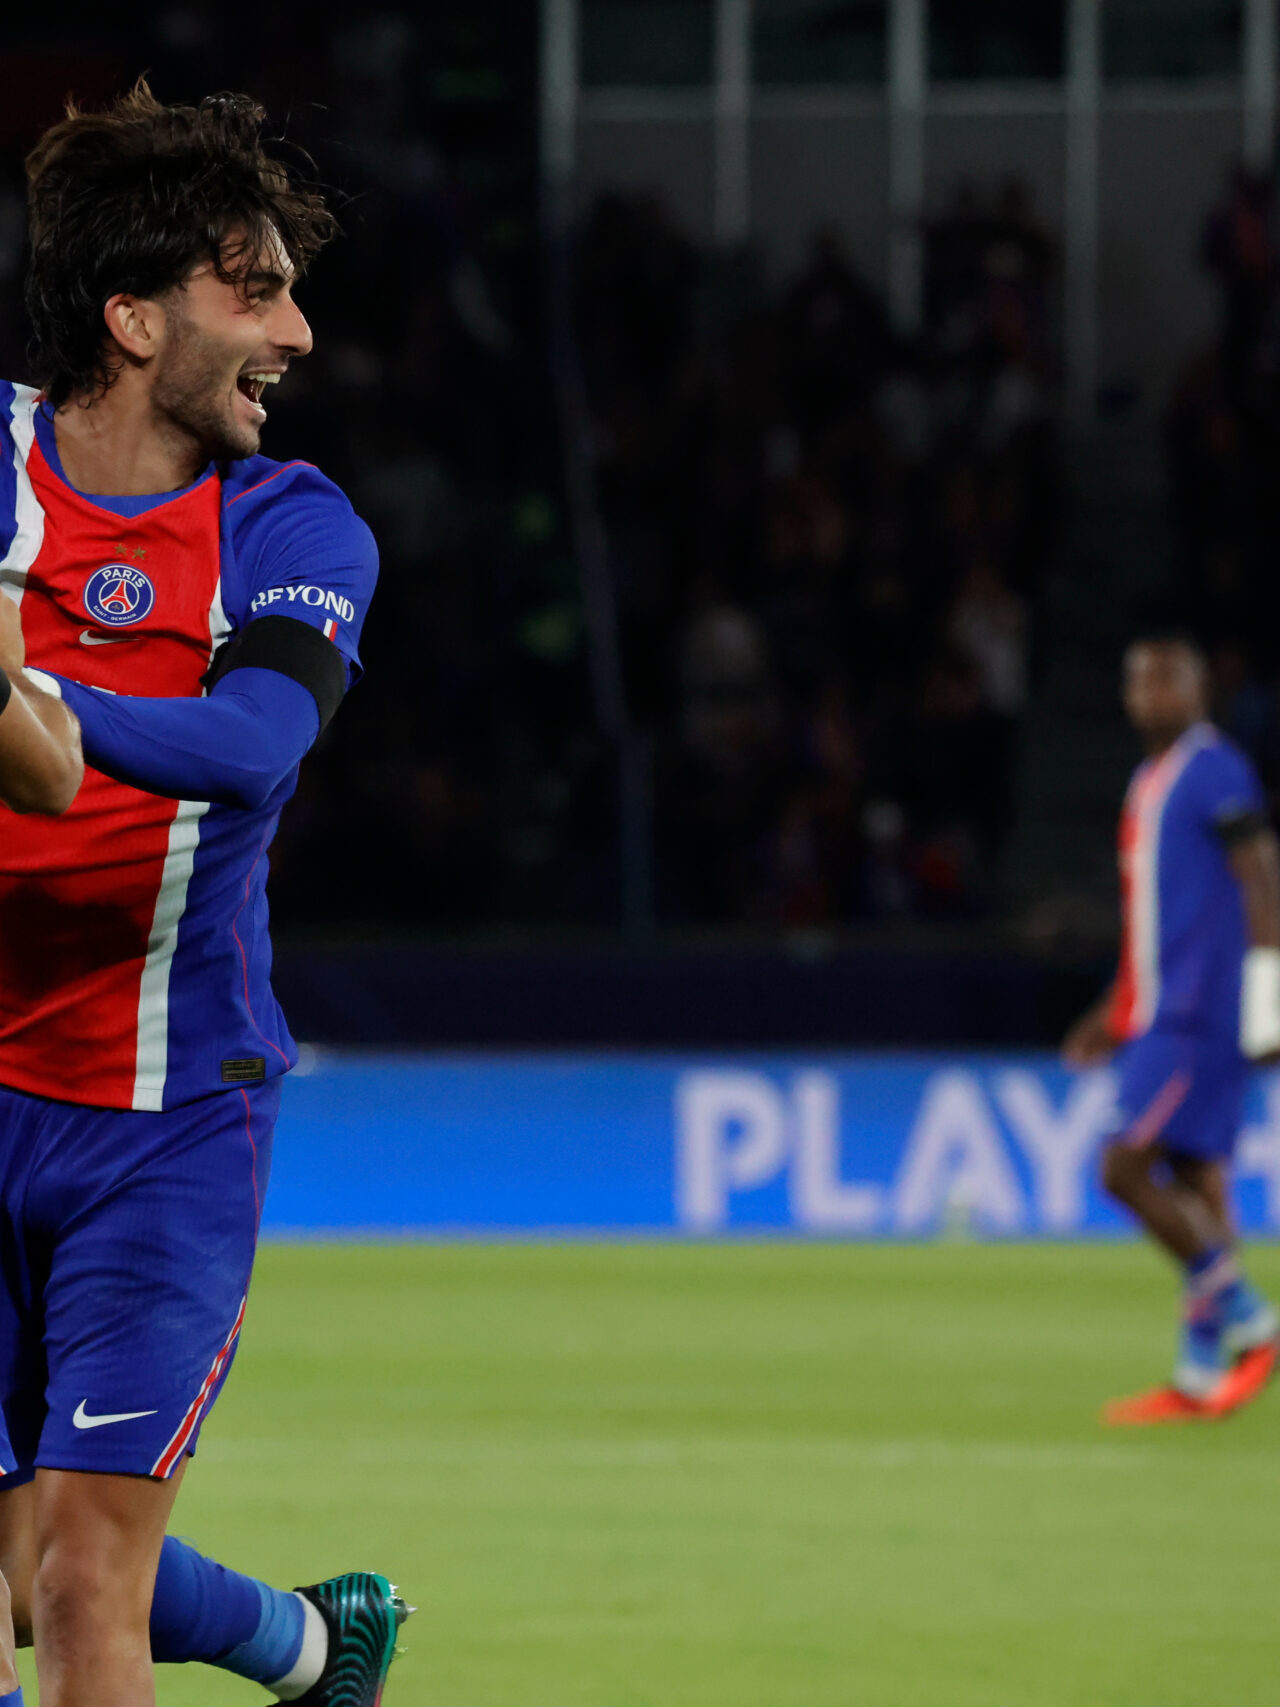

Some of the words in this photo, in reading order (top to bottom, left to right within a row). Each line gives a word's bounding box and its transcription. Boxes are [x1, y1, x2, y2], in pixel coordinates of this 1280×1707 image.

[101, 568, 146, 588] PARIS
[251, 585, 355, 623] BEYOND
[674, 1066, 1118, 1235] PLAY
